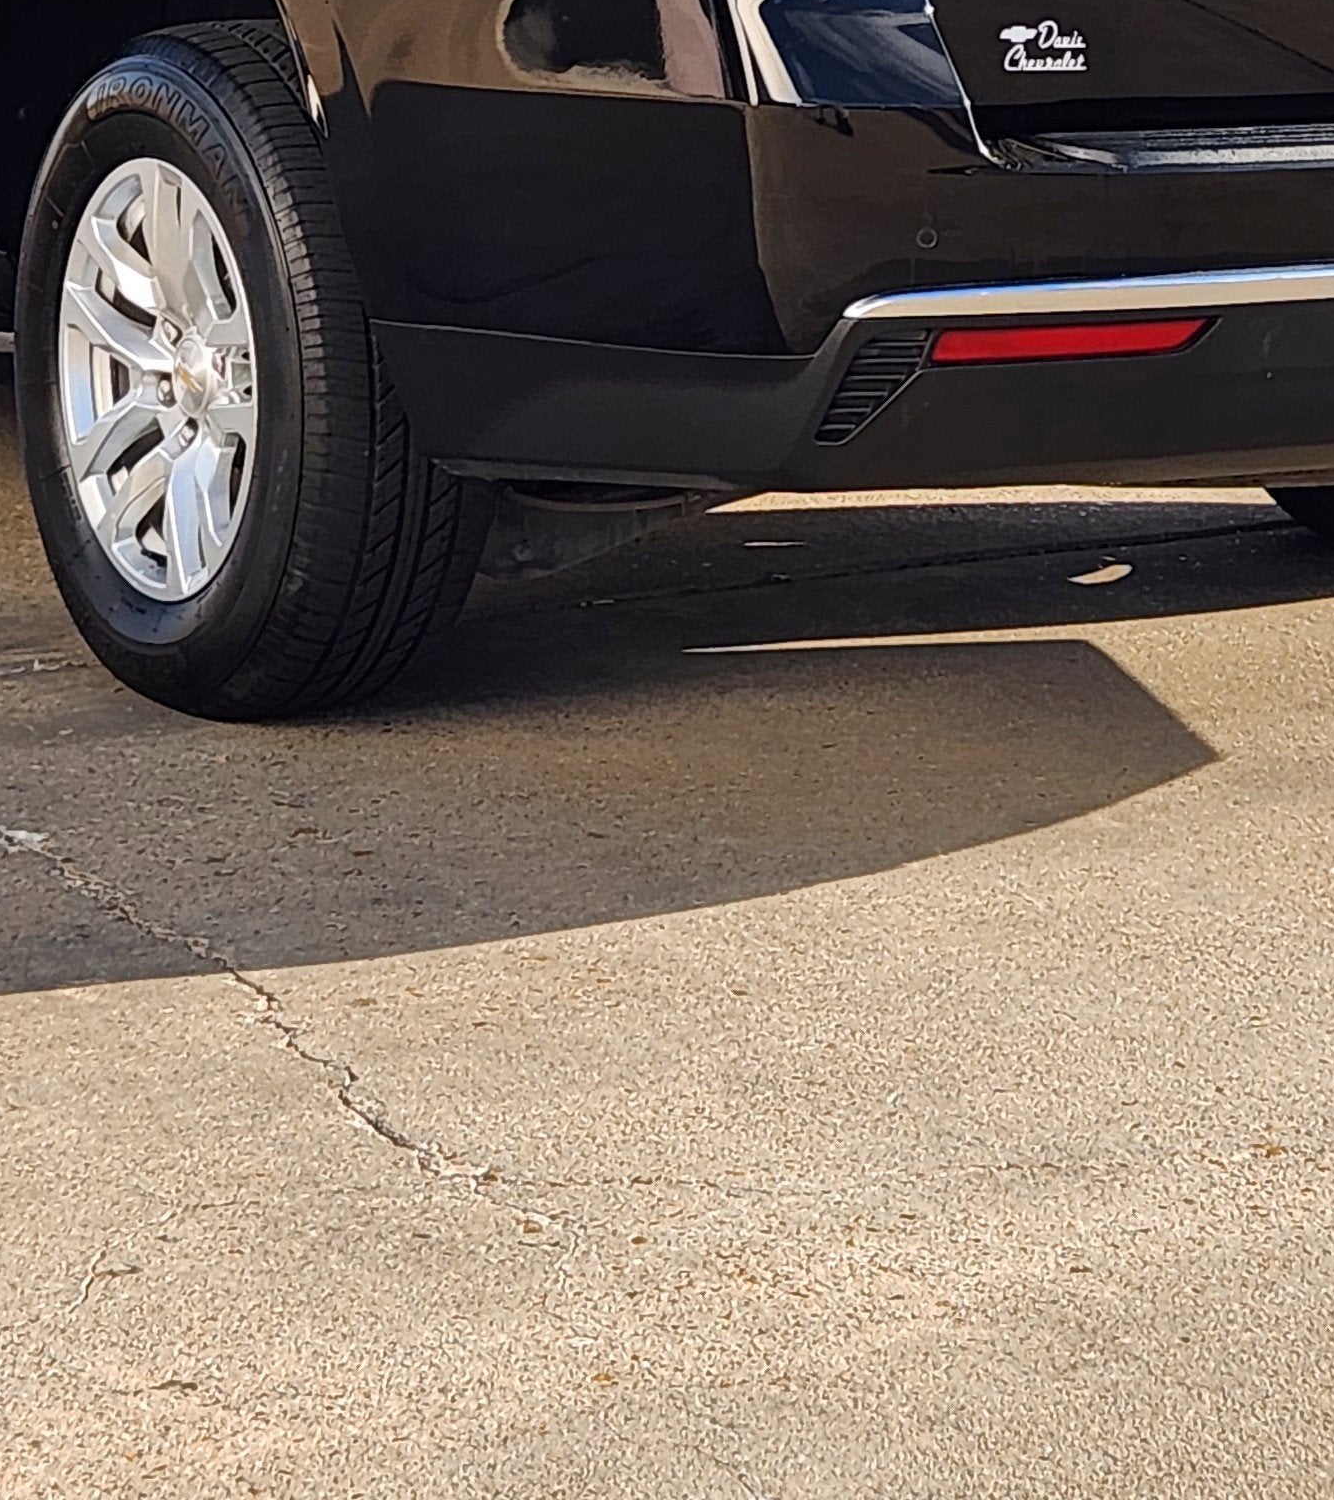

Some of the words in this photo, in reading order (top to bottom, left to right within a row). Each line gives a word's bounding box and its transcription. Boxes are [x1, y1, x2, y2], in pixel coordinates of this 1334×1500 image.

[1038, 20, 1086, 49] Davis
[1003, 43, 1087, 71] Chevrolet
[93, 74, 249, 220] IRONMAN
